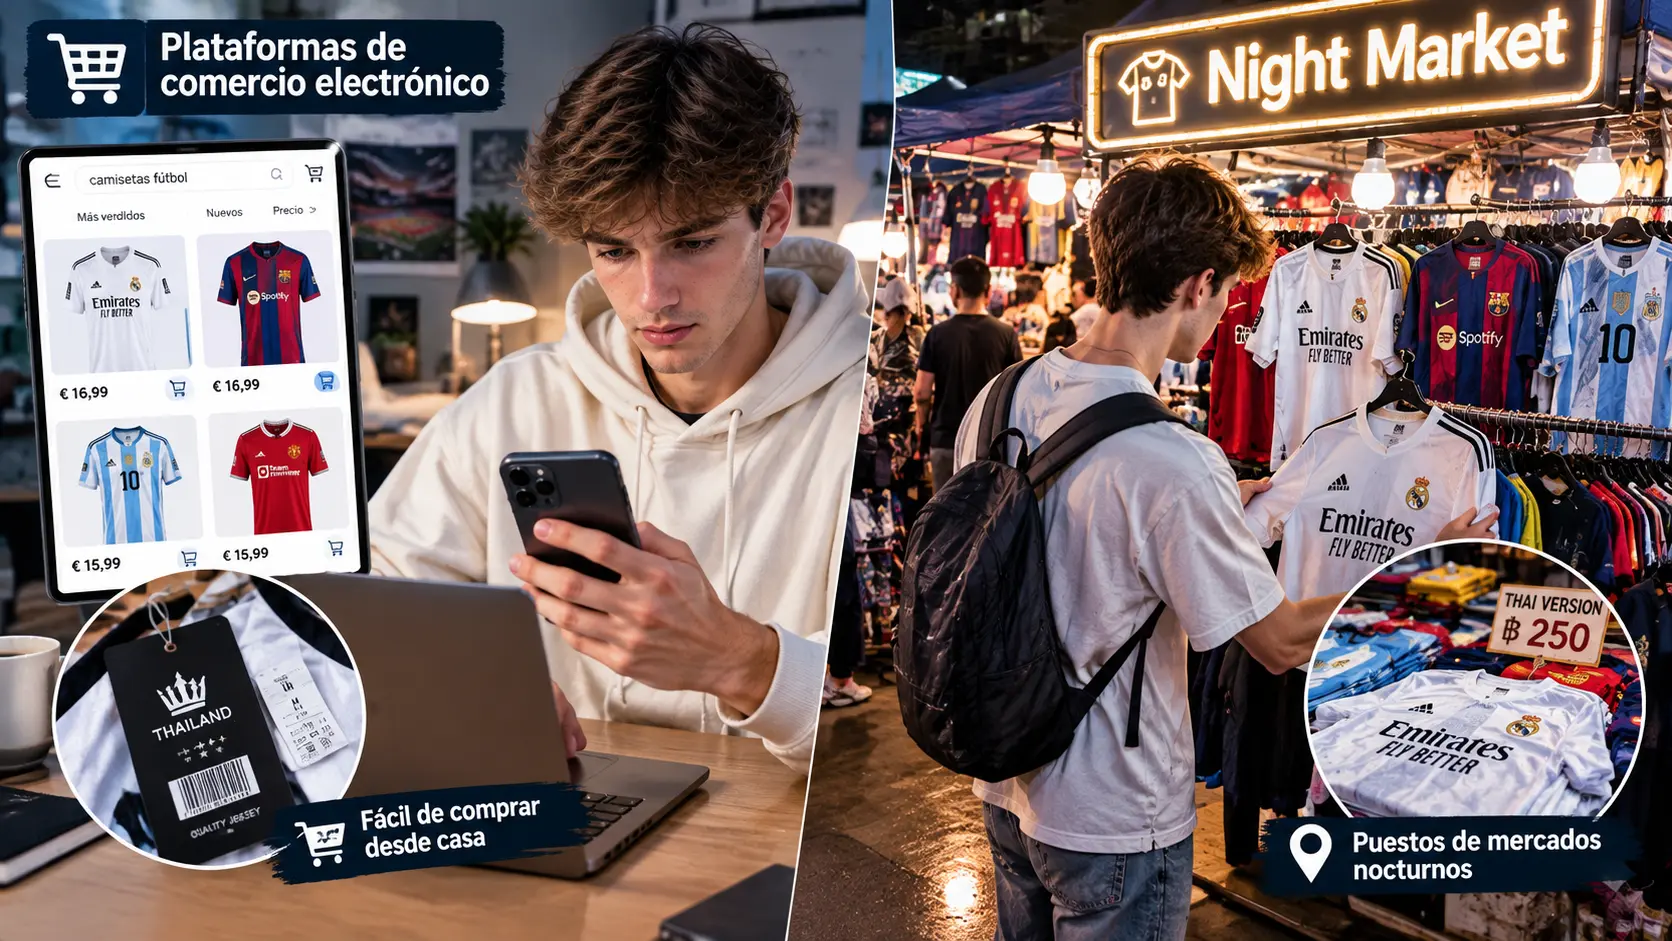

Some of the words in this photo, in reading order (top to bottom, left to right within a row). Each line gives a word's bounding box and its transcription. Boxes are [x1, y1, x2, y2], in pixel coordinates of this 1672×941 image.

[1208, 35, 1350, 112] Night
[1366, 8, 1568, 86] Market
[89, 173, 150, 186] camisetas
[153, 171, 188, 184] fútbol
[77, 211, 99, 222] Más
[206, 208, 243, 219] Nuevos
[273, 205, 304, 216] Precio
[92, 296, 140, 309] Emirates
[1298, 326, 1363, 350] Emirates
[1459, 330, 1504, 348] Spotify
[1598, 323, 1636, 364] 10
[1308, 348, 1321, 363] FLY
[1323, 348, 1353, 366] BETTER
[59, 388, 68, 400] €
[72, 386, 108, 401] 16,99
[213, 380, 222, 393] €
[224, 379, 260, 394] 16,99
[120, 470, 140, 492] 10
[1319, 507, 1415, 547] Emirates
[223, 550, 232, 562] €
[234, 547, 269, 562] 15,99
[1328, 537, 1352, 557] FLY
[1351, 540, 1395, 564] BETTER
[72, 560, 80, 573] €
[84, 557, 121, 574] 15,99
[1505, 593, 1537, 610] THAI
[1542, 596, 1604, 615] VERSION
[1527, 618, 1590, 652] 250
[152, 706, 232, 741] THAILAND
[1379, 720, 1514, 761] Emirates
[1376, 740, 1415, 758] FLY
[1408, 747, 1480, 775] BETTER
